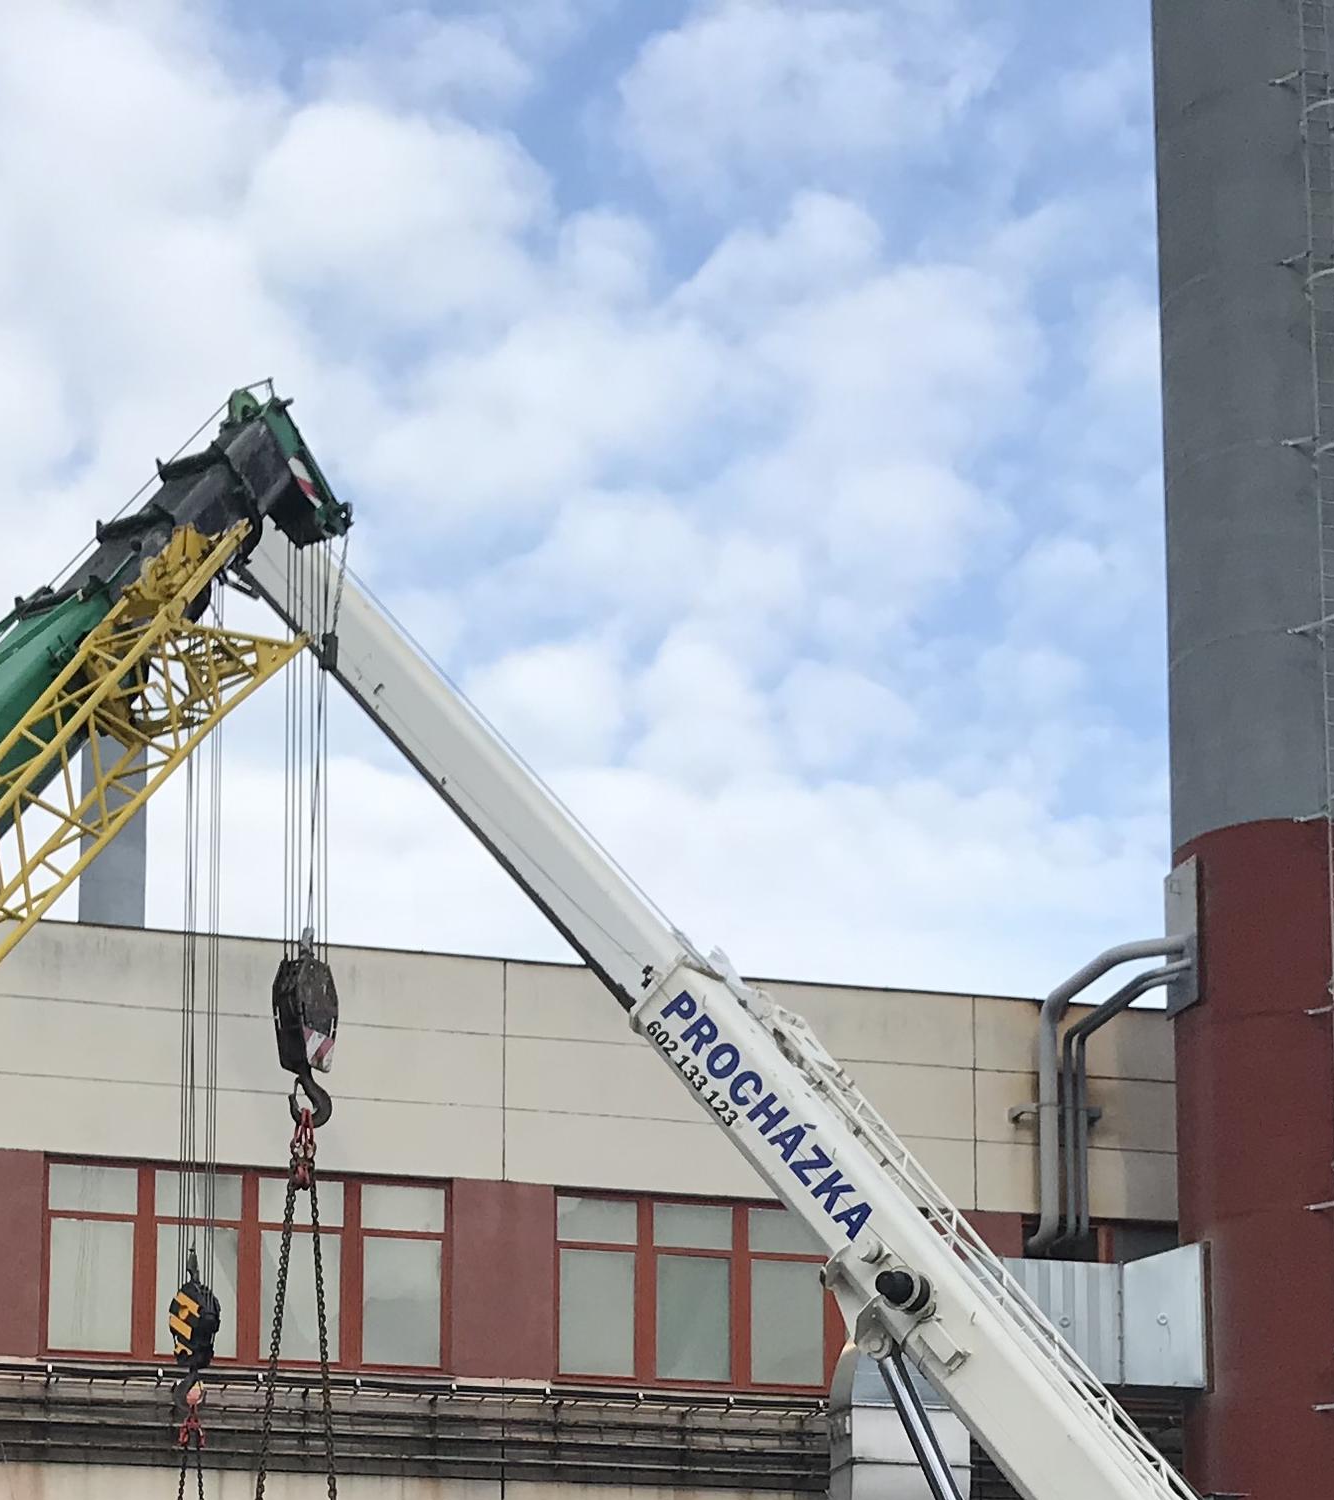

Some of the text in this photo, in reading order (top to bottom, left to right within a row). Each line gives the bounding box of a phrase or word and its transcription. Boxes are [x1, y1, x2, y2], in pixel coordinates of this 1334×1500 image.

[646, 1020, 739, 1128] 602 133 123
[660, 990, 873, 1242] PROCHÁZKA
